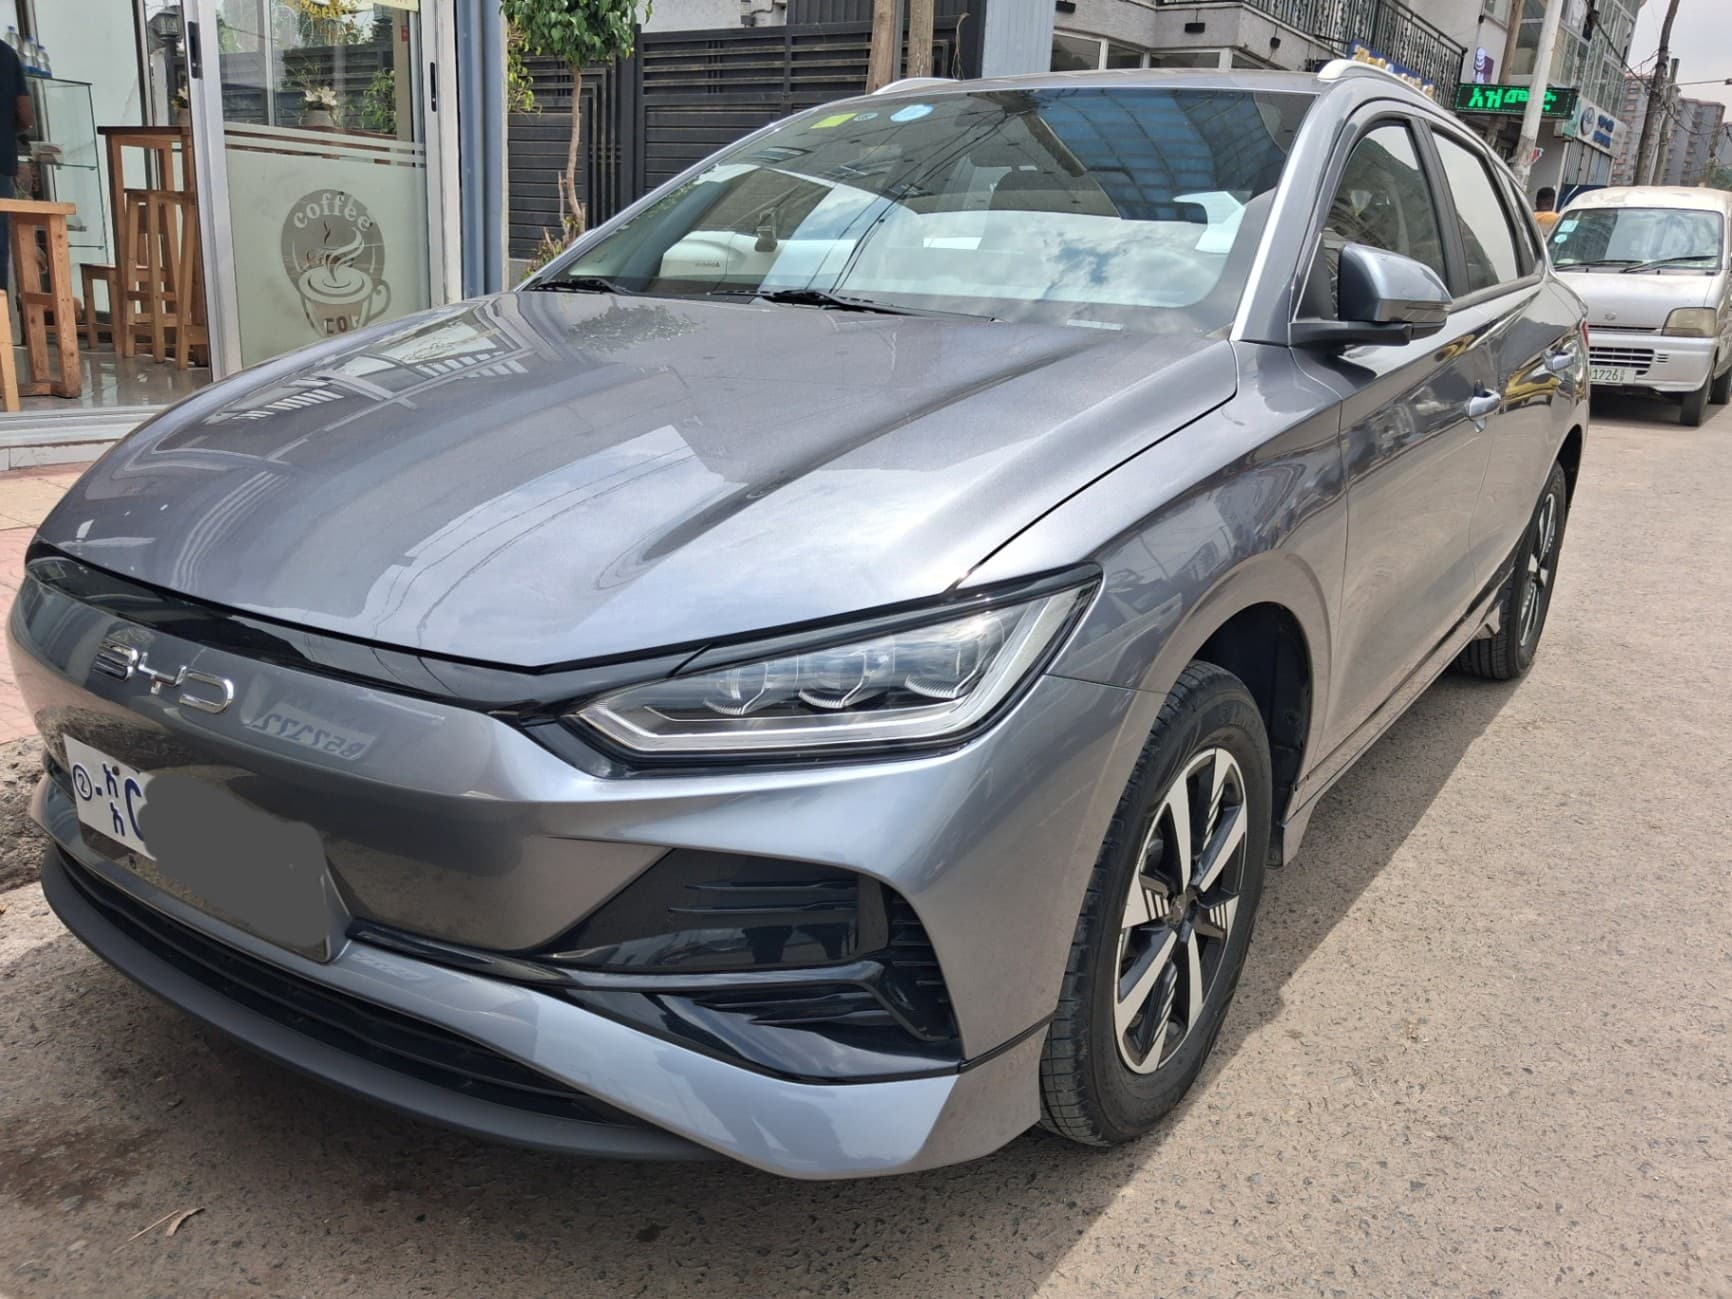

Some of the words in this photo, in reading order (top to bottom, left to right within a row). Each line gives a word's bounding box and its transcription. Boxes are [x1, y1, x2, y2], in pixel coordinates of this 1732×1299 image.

[294, 192, 372, 231] coffee
[1589, 367, 1618, 381] 1726
[92, 638, 234, 714] BYD
